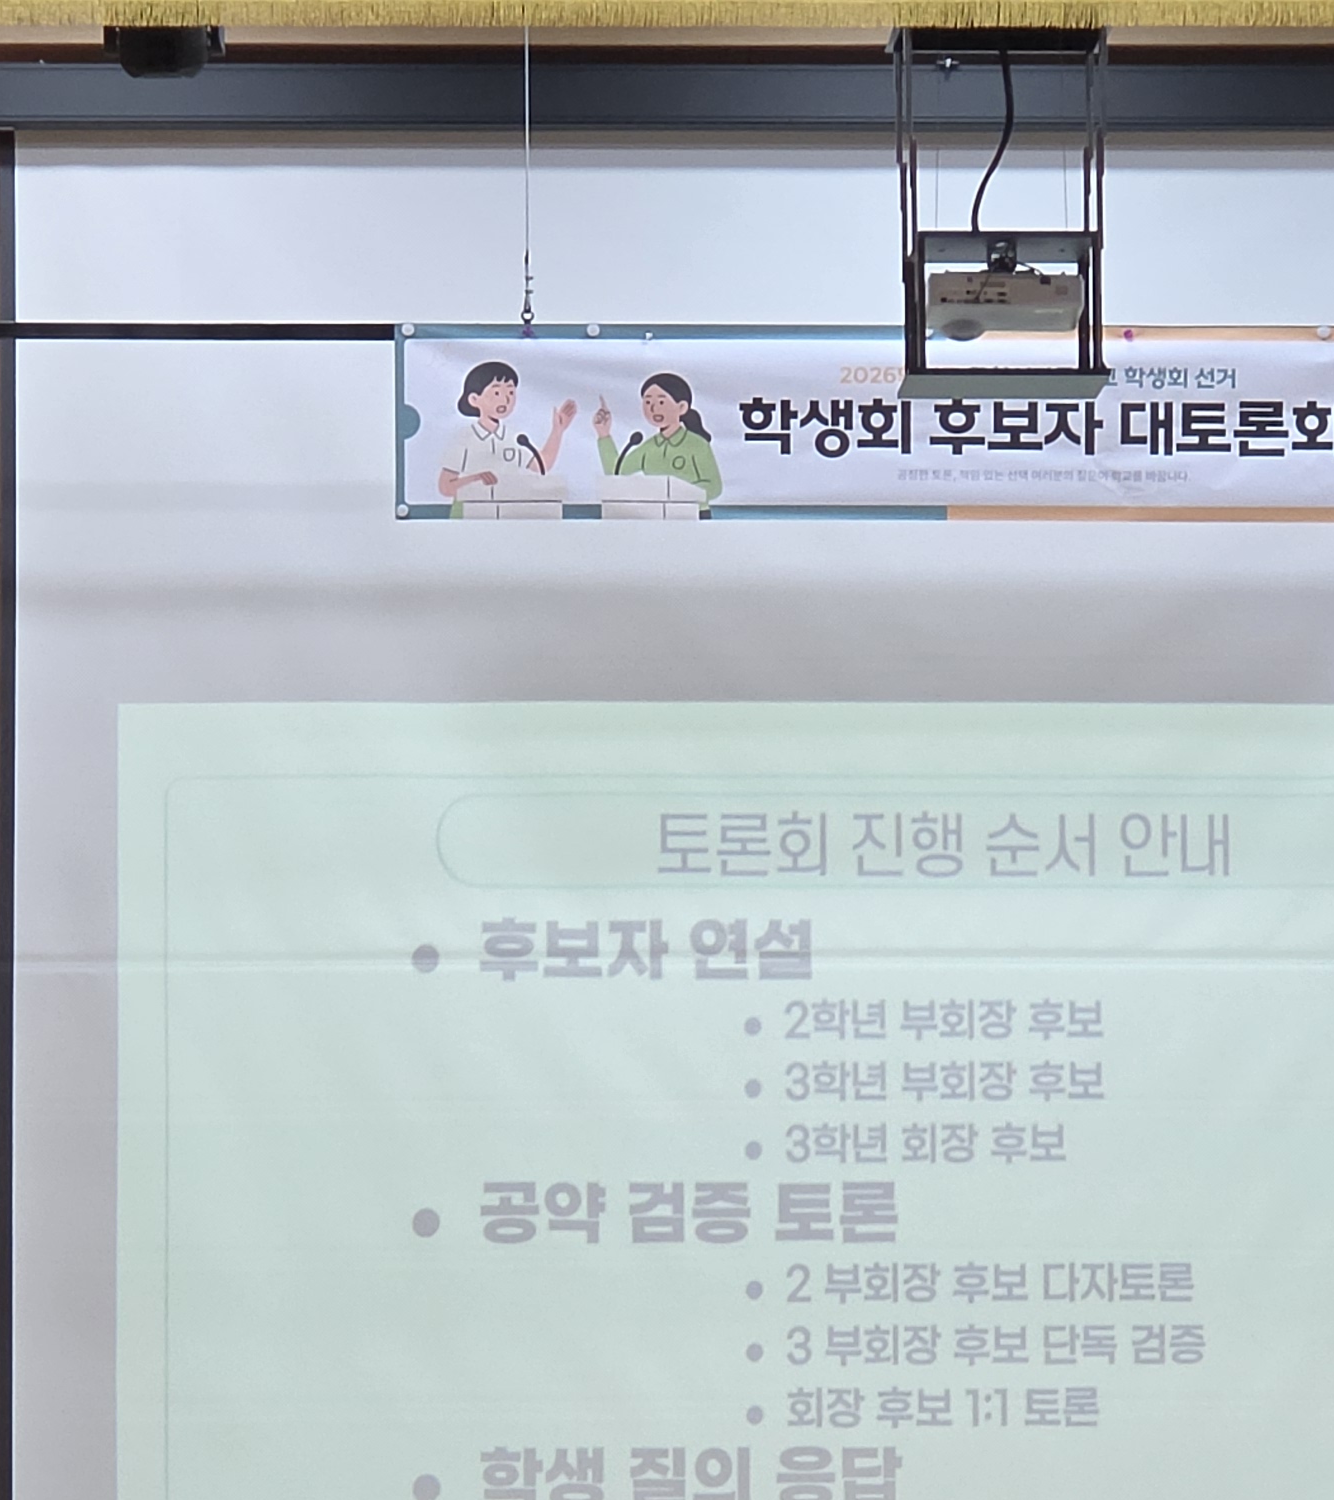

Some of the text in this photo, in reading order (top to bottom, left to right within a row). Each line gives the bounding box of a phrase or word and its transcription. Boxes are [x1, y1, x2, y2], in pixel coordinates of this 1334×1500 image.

[1124, 366, 1188, 389] 학생회
[1194, 367, 1236, 389] 선거
[739, 397, 912, 458] 학생회
[929, 398, 1104, 456] 후보자
[1007, 469, 1028, 481] 선택
[657, 810, 1231, 878] 토론회 진행 순서 안내
[479, 917, 813, 981] 후보자 연설
[784, 998, 1105, 1041] 2학년 부회장 후보
[785, 1060, 1105, 1103] 3학년 부회장 후보
[785, 1122, 1067, 1165] 3학년 회장 후보
[480, 1181, 899, 1246] 공약 검증 토론
[786, 1262, 1195, 1304] 2 부회장 후보 다자토론
[786, 1323, 1206, 1367] 3 부회장 후보 단독 검증
[787, 1386, 1101, 1429] 회장 후보 1:1 토론
